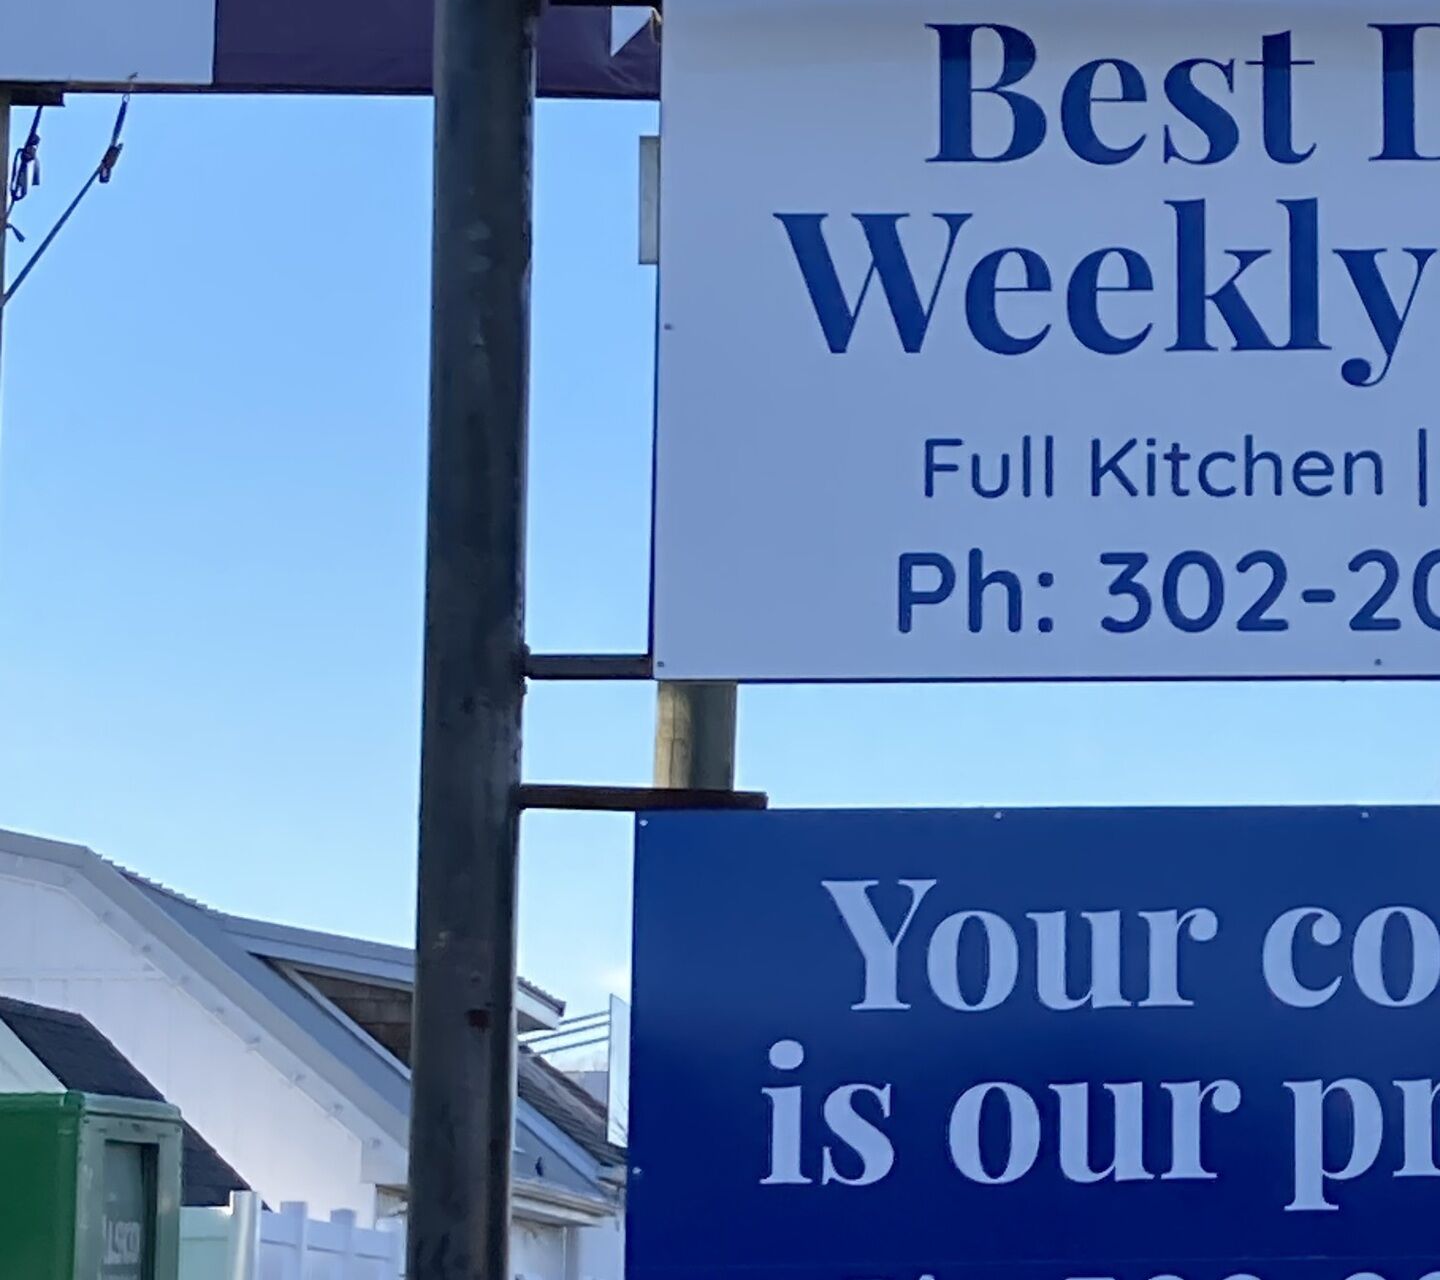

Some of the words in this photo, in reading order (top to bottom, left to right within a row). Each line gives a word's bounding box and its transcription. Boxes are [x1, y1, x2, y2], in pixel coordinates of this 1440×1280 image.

[925, 22, 1316, 165] Best
[773, 198, 1437, 387] Weekly
[923, 435, 1053, 498] Full
[1090, 435, 1384, 498] Kitchen
[898, 548, 1053, 633] Ph:
[822, 880, 1217, 1010] Your
[760, 1040, 894, 1185] is
[949, 1080, 1241, 1183] our
